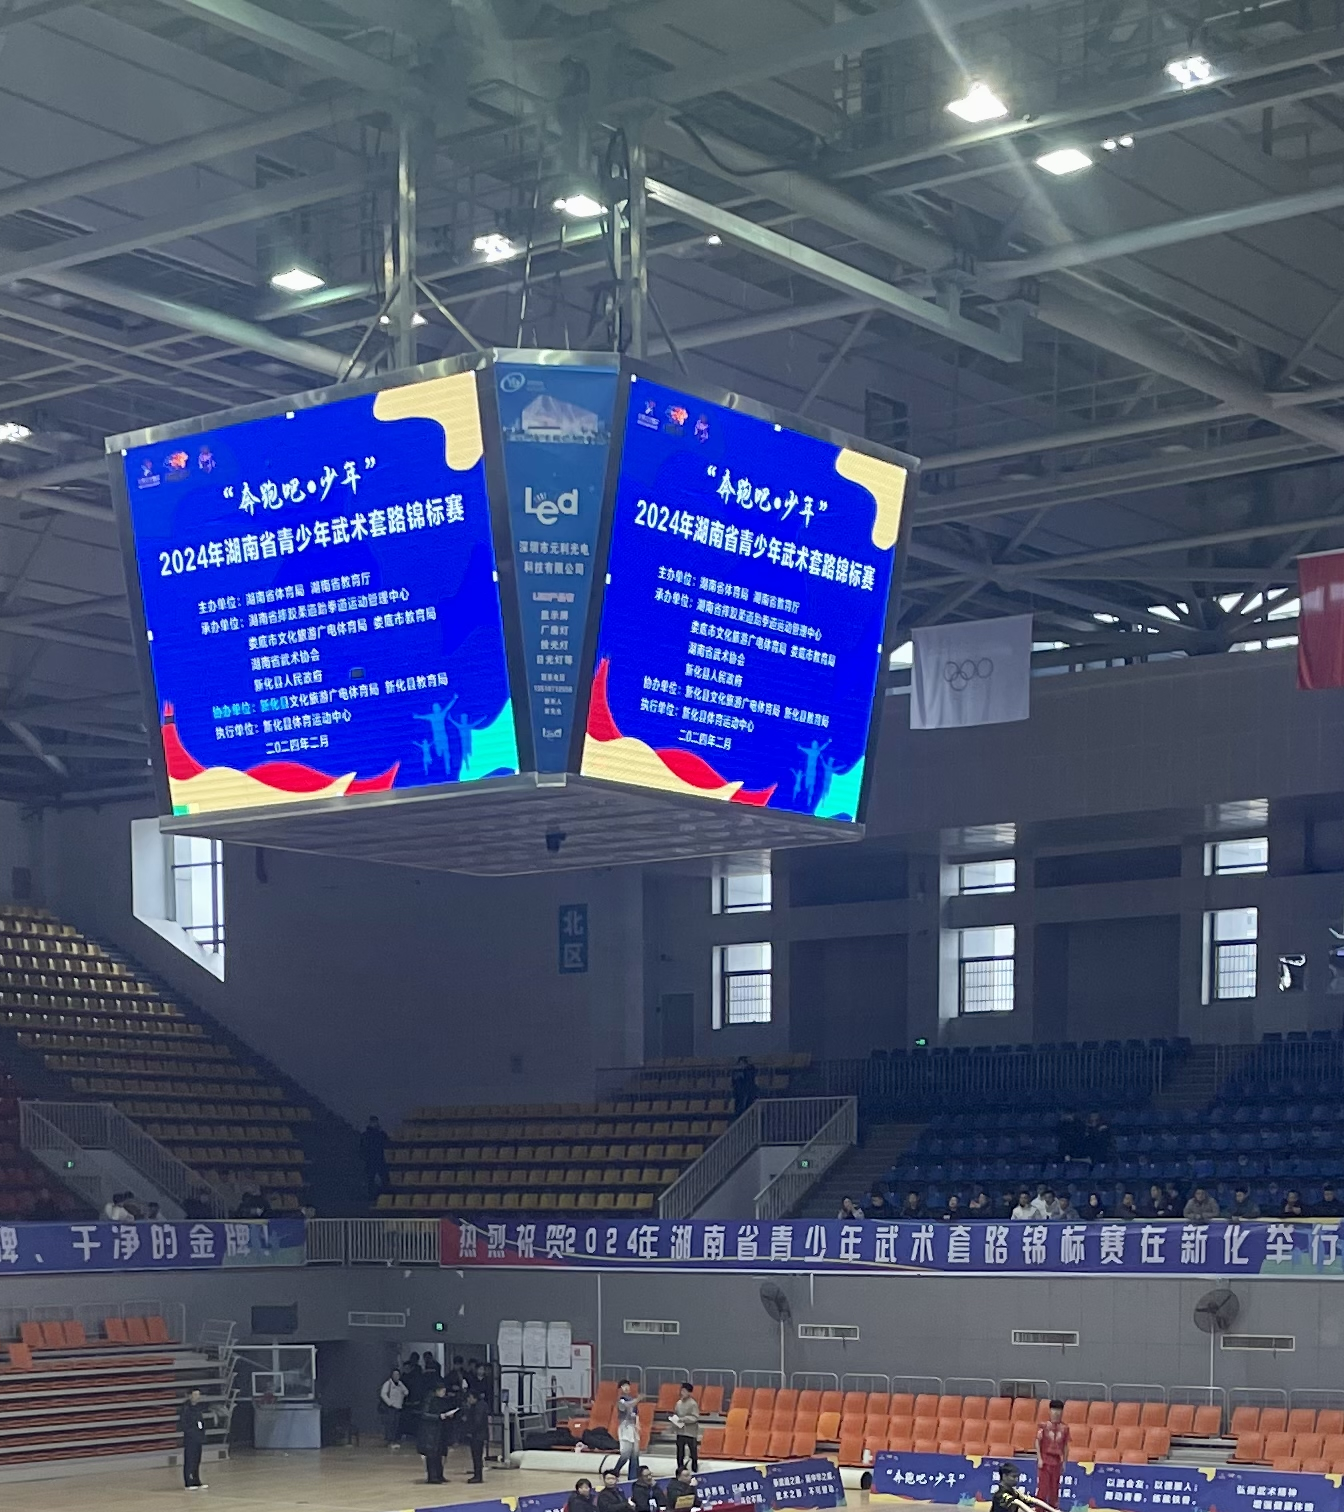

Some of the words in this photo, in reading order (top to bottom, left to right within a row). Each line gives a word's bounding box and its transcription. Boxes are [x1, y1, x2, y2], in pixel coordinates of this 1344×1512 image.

[159, 493, 465, 577] 2024年湖南省青少年武术套路锦标赛
[634, 500, 876, 591] 2024年湖南省青少年武术套路锦标赛
[524, 561, 584, 576] 科技有限公司
[311, 572, 371, 595] 湖南省教育厅
[753, 591, 800, 614] 湖南省教育厅
[373, 606, 437, 631] 娄底市教育局
[251, 648, 320, 671] 湖南省武术协会
[688, 641, 745, 667] 湖南省武术协会
[254, 670, 323, 692] 新化县人民政府
[385, 671, 448, 694] 新化县教育局
[685, 662, 743, 688] 新化县人民政府
